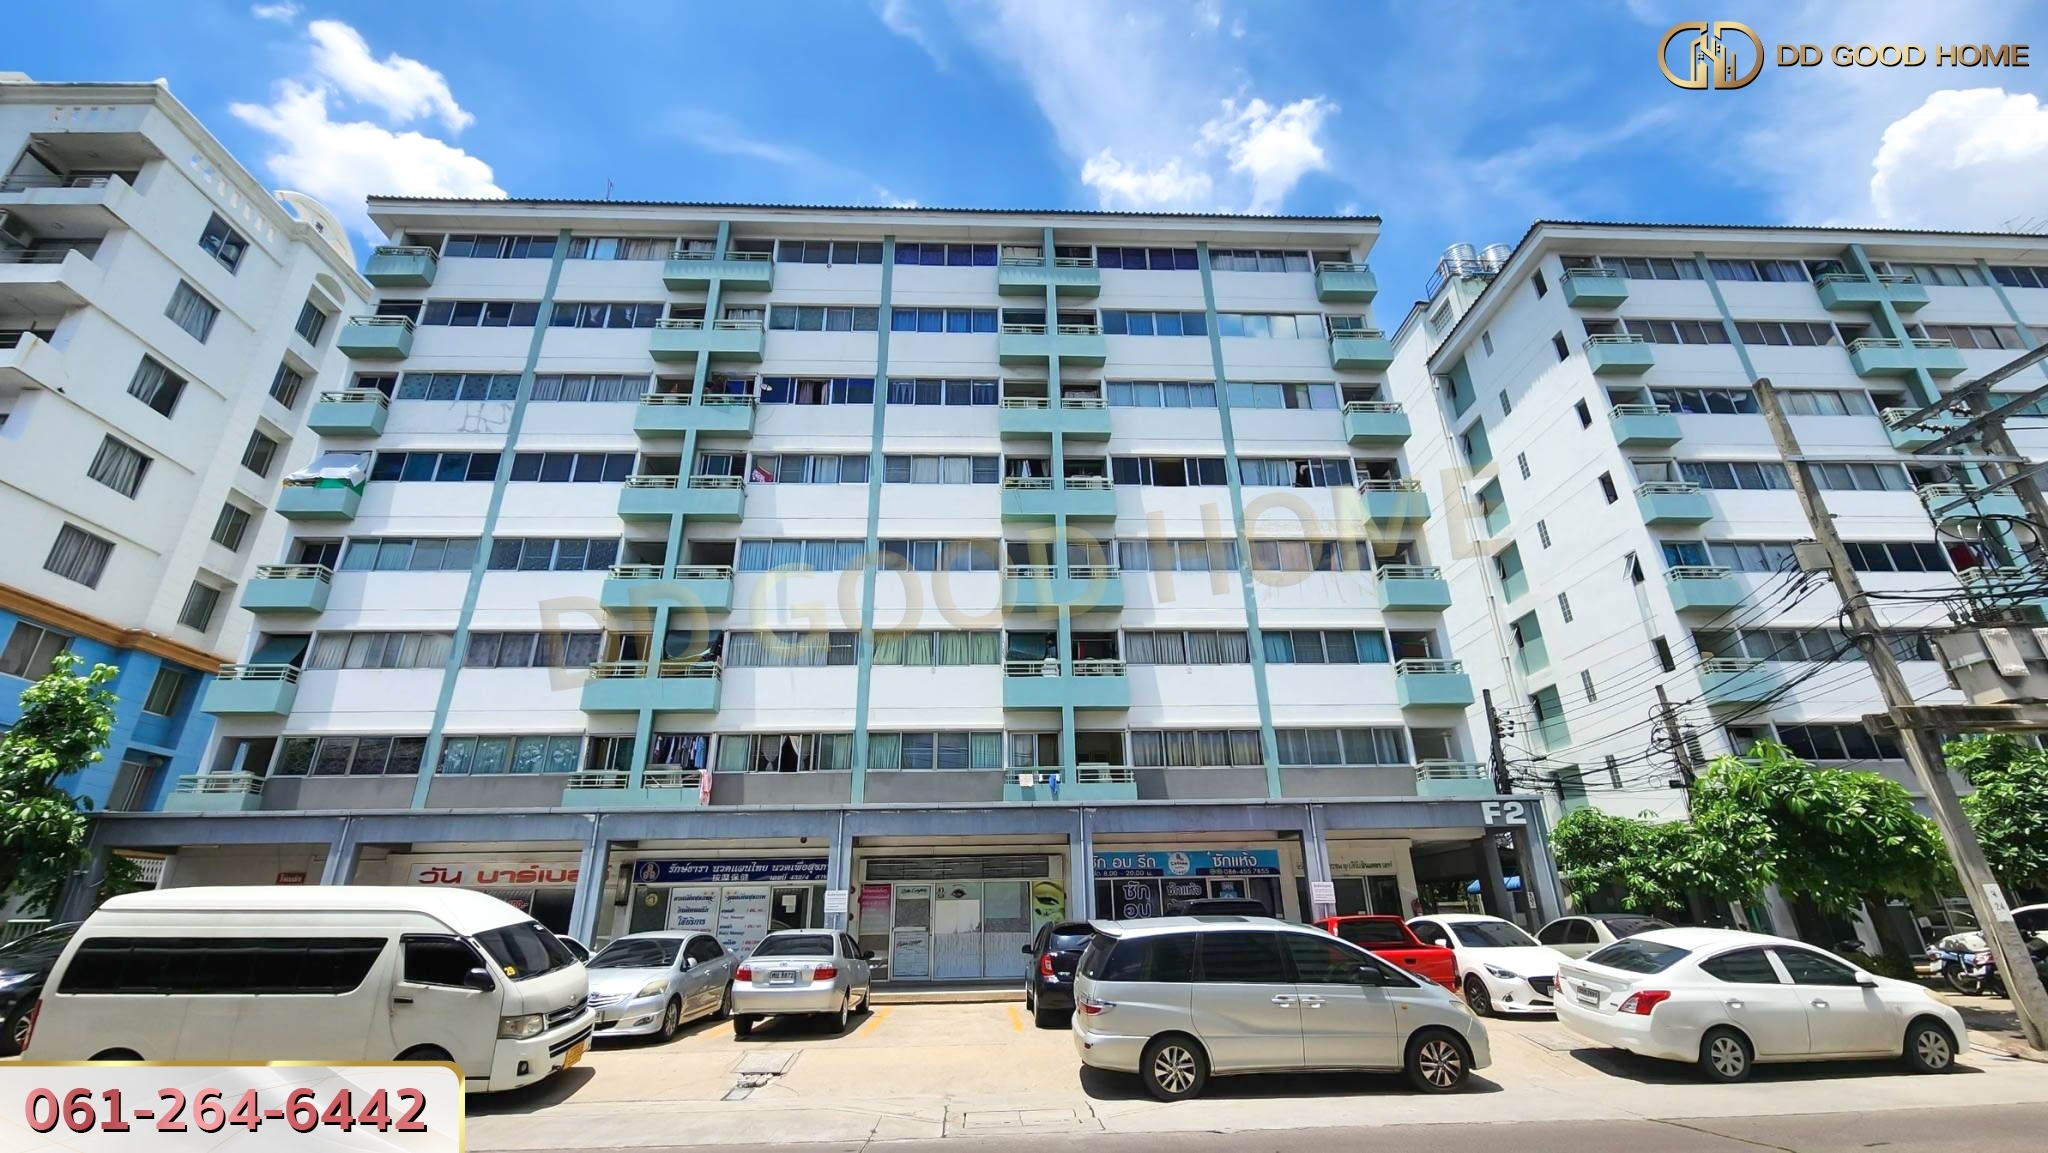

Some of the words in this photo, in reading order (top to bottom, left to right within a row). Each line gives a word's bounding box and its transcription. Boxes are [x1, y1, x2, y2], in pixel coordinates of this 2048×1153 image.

[1481, 801, 1527, 825] F2
[772, 860, 827, 874] นวดเพื่อสุขภ
[1113, 858, 1131, 868] อบ
[1137, 854, 1156, 868] รีด
[1212, 851, 1258, 867] ซักแห้ง
[419, 867, 462, 884] วัน
[1122, 880, 1151, 902] ซัก
[1123, 903, 1152, 919] อบ
